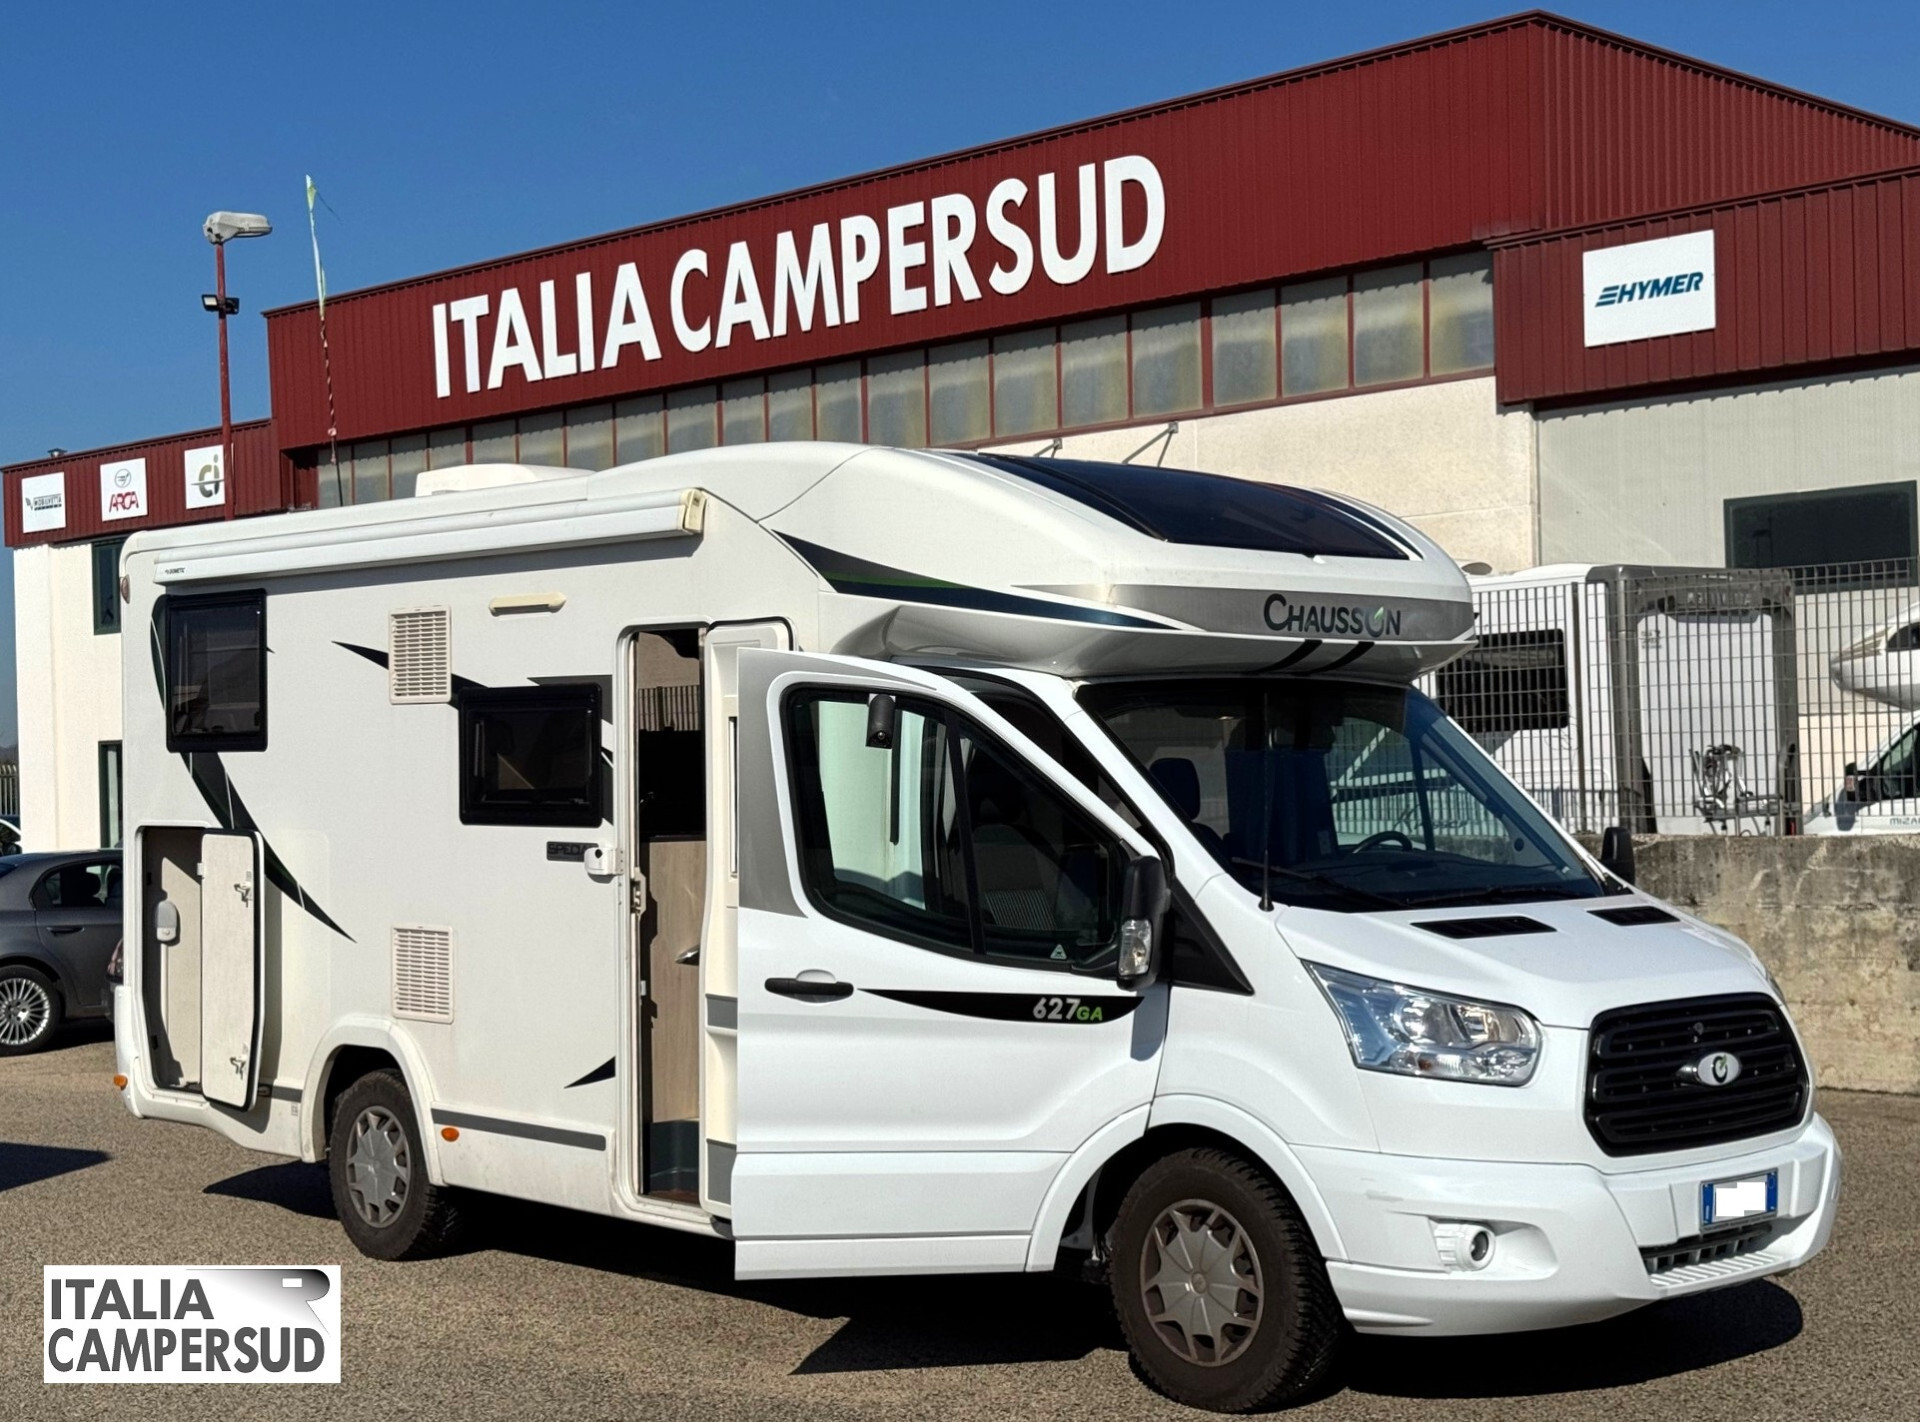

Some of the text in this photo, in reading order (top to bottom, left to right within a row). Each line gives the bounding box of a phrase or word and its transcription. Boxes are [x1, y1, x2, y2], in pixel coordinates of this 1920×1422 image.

[432, 154, 1166, 398] ITALIA CAMPERSUD
[1616, 271, 1705, 304] HYMER
[108, 490, 140, 513] ARCA
[1263, 592, 1401, 638] CHAUSSON
[1032, 996, 1103, 1021] 627GA
